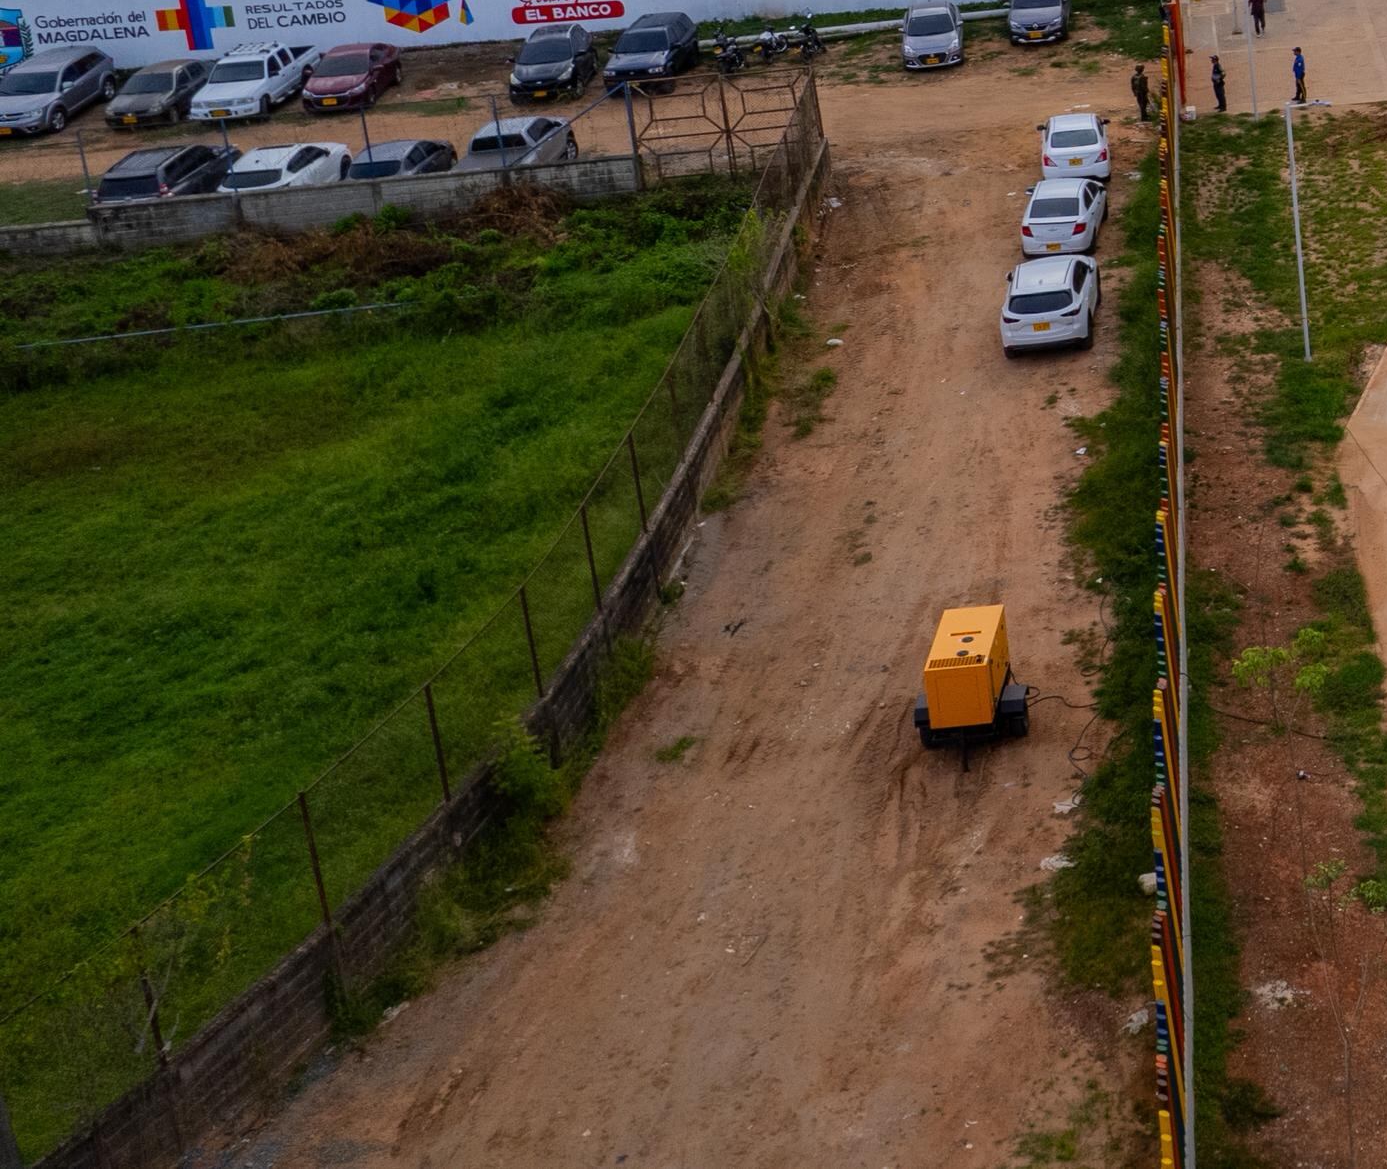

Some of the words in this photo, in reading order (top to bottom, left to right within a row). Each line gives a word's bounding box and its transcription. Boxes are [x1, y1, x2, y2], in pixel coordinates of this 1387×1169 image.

[34, 11, 123, 29] Gobernación
[127, 10, 146, 23] del
[247, 16, 274, 30] DEL
[276, 11, 346, 28] CAMBIO
[525, 8, 547, 21] EL
[552, 4, 612, 19] BANCO
[36, 25, 150, 45] MAGDALENA
